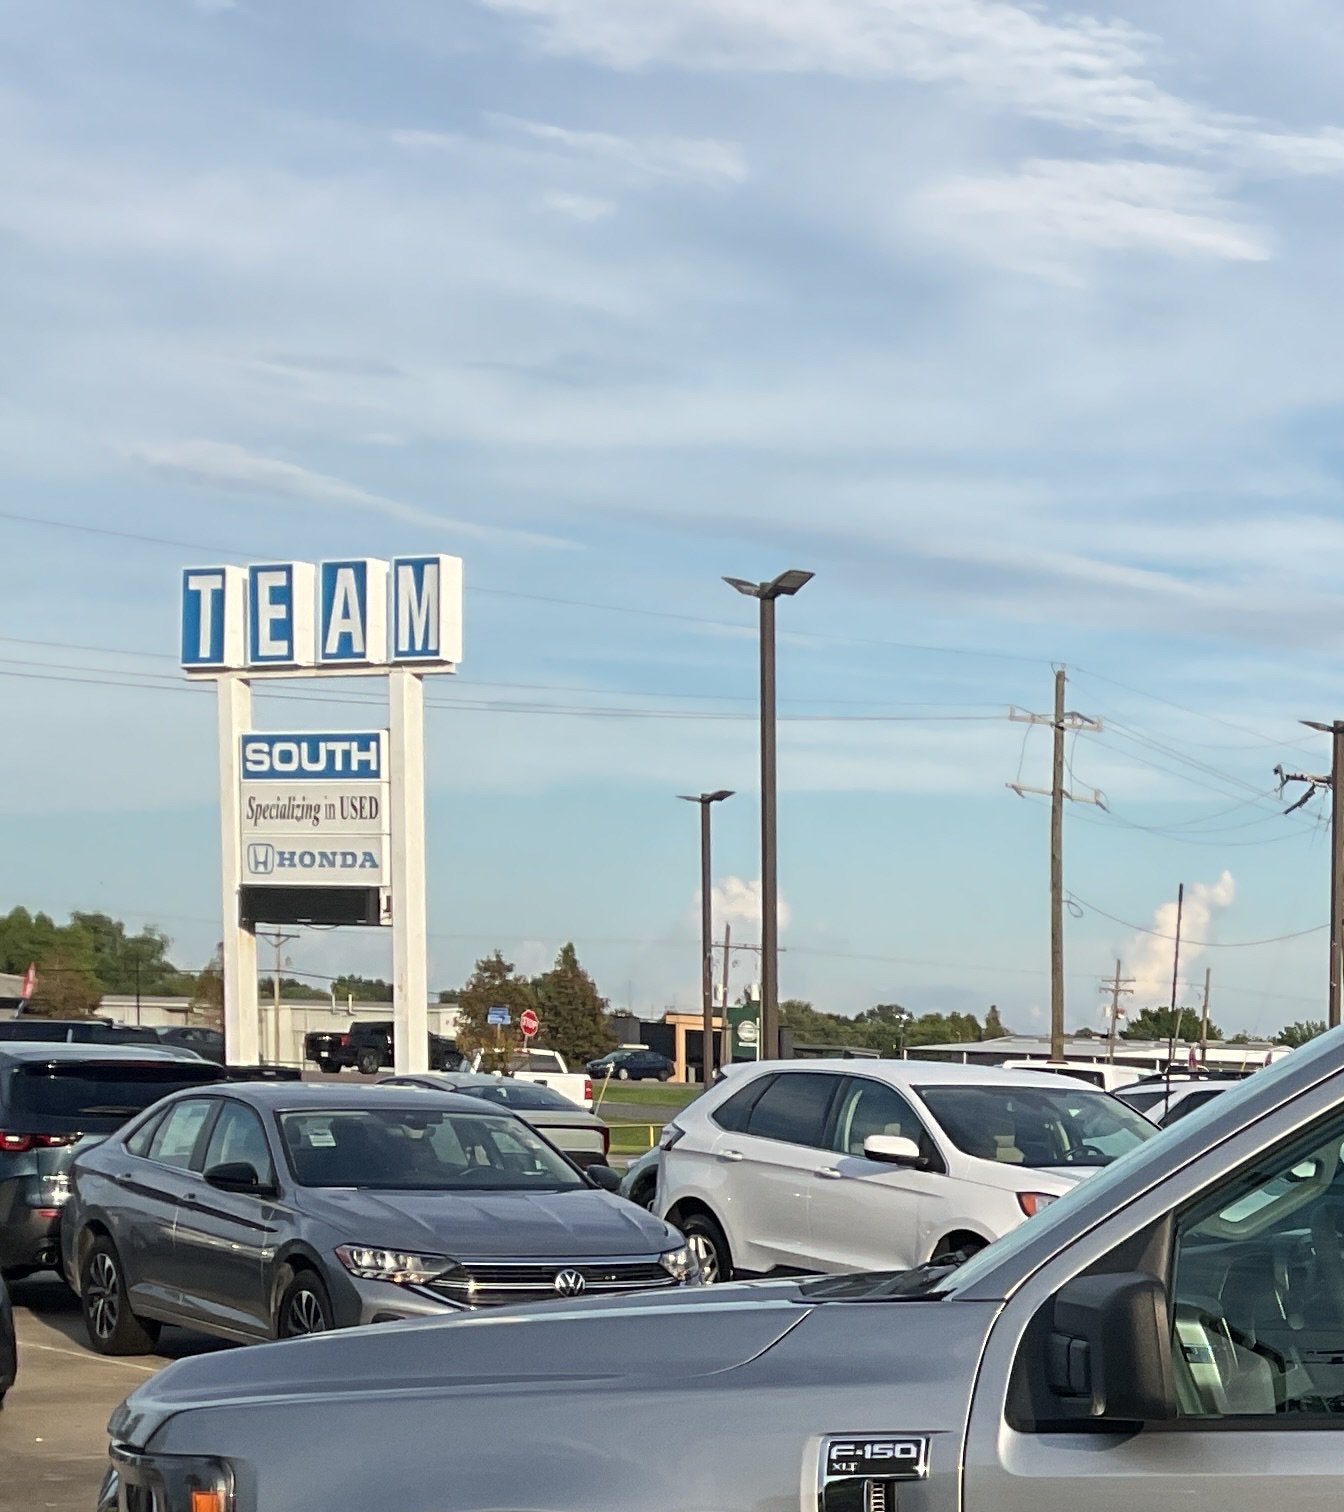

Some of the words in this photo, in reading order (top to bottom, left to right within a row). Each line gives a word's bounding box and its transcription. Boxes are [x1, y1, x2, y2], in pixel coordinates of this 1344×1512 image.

[188, 564, 438, 658] TEAM
[246, 741, 378, 772] SOUTH
[246, 795, 321, 827] Specializing
[324, 795, 336, 820] in
[339, 795, 379, 820] USED
[276, 851, 379, 869] HONDA
[830, 1443, 918, 1460] F-150
[832, 1462, 858, 1472] XLT
